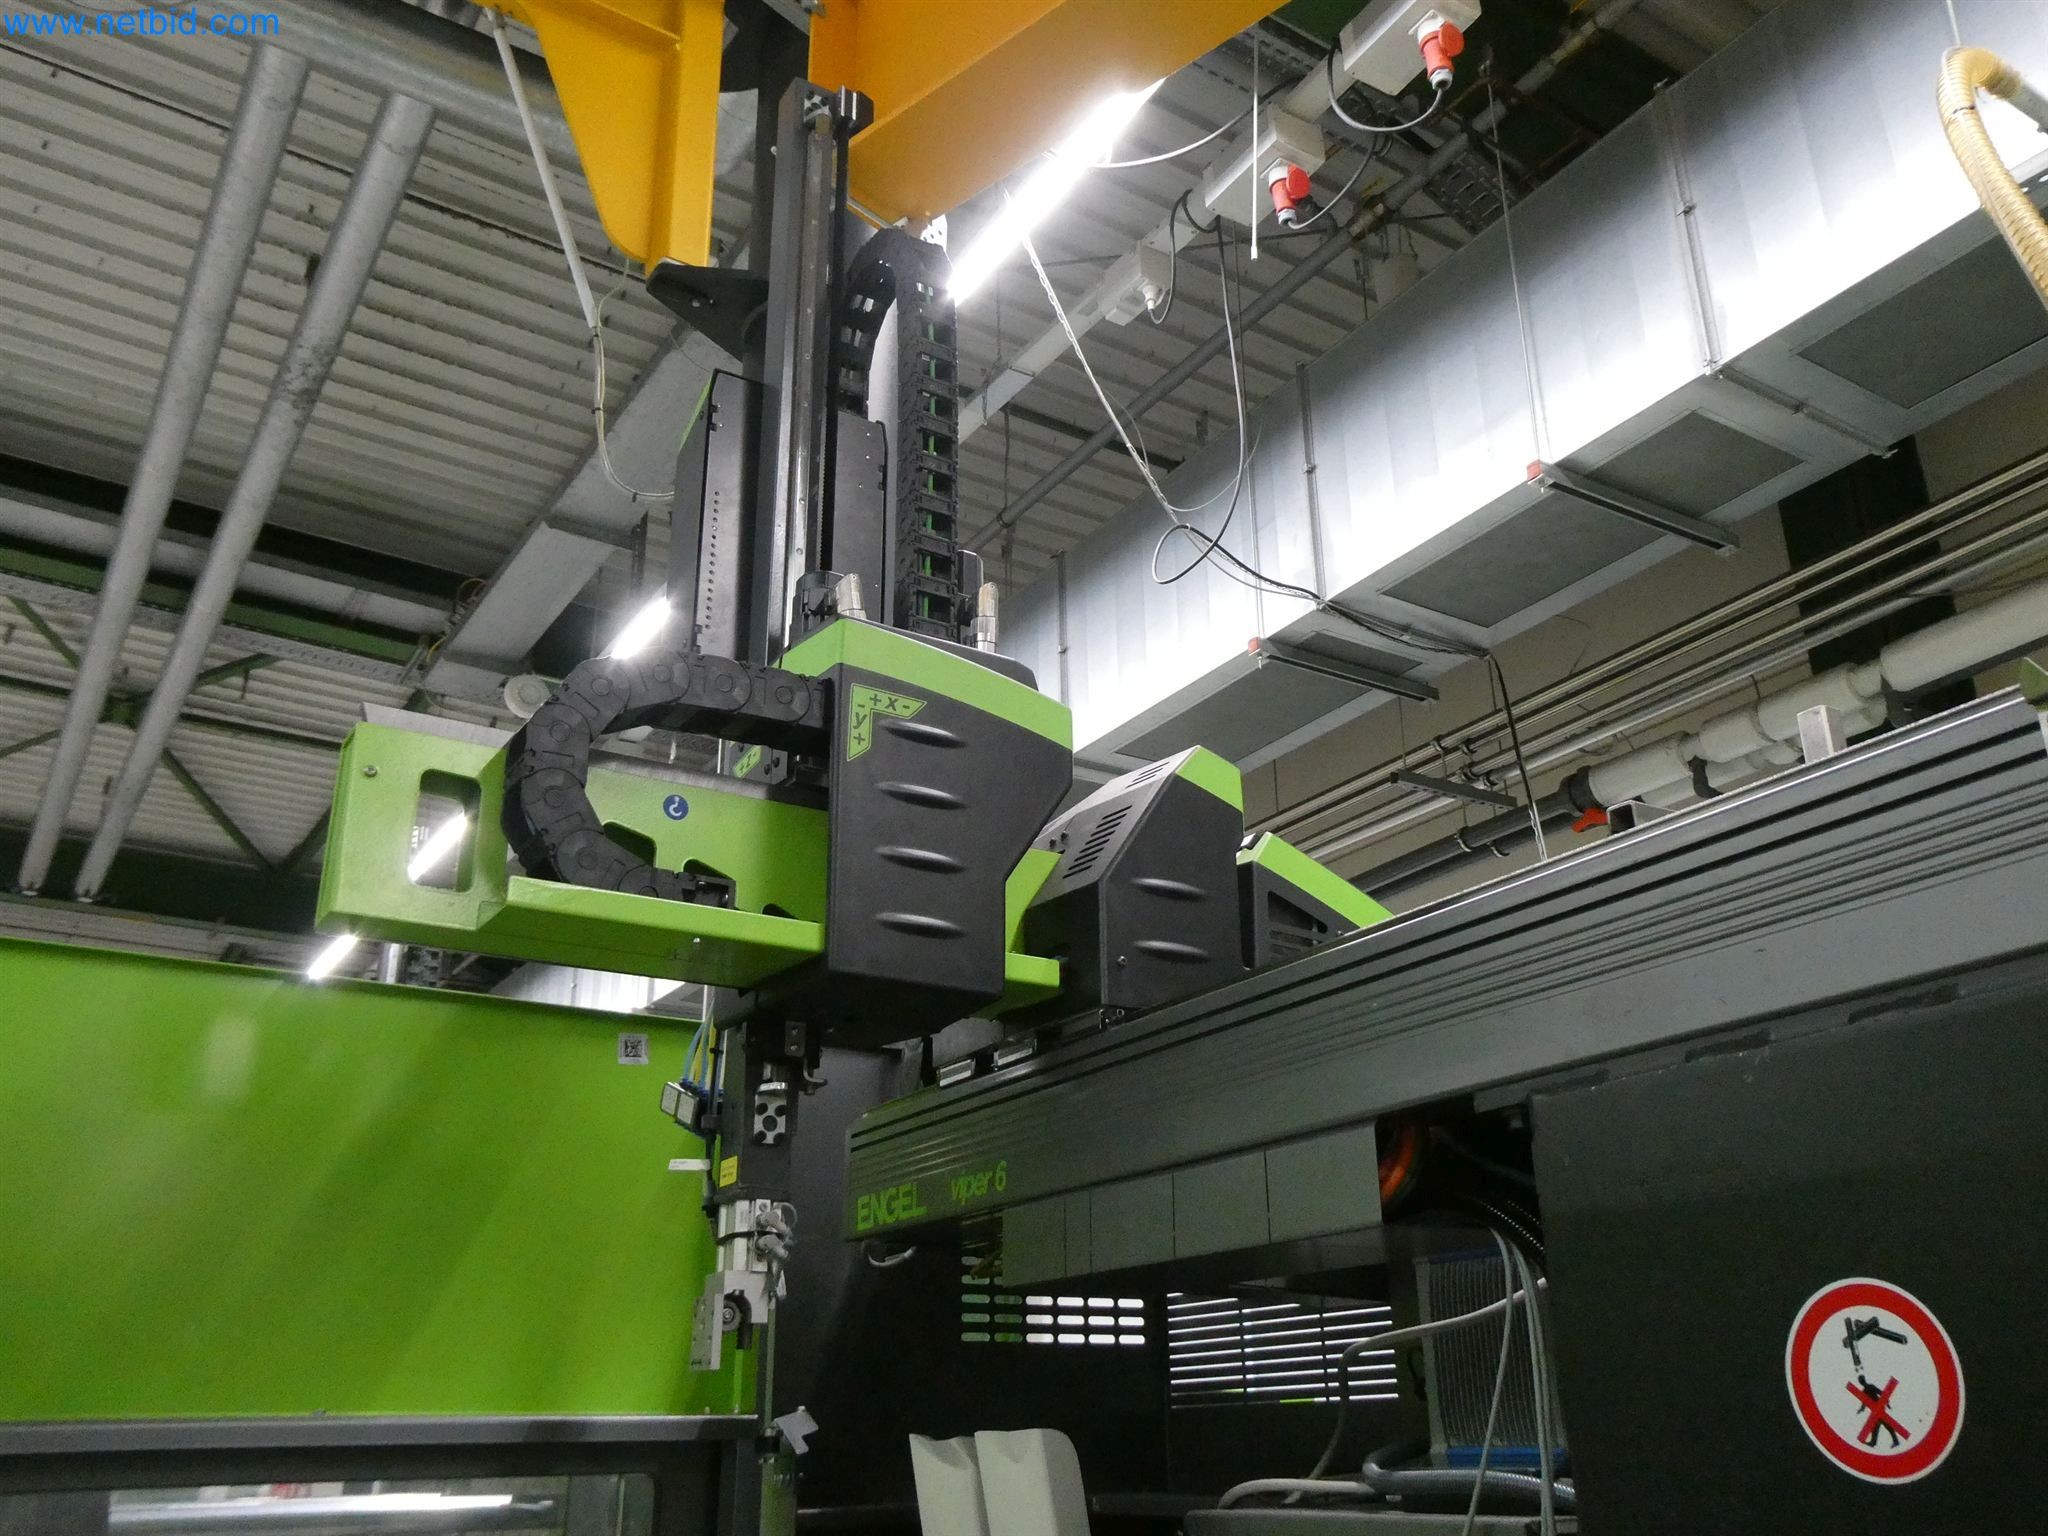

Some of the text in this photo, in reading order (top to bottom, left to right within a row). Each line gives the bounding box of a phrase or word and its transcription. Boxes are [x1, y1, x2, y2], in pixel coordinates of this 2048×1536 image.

[951, 1160, 1007, 1205] viper 6
[857, 1182, 928, 1232] ENGEL
